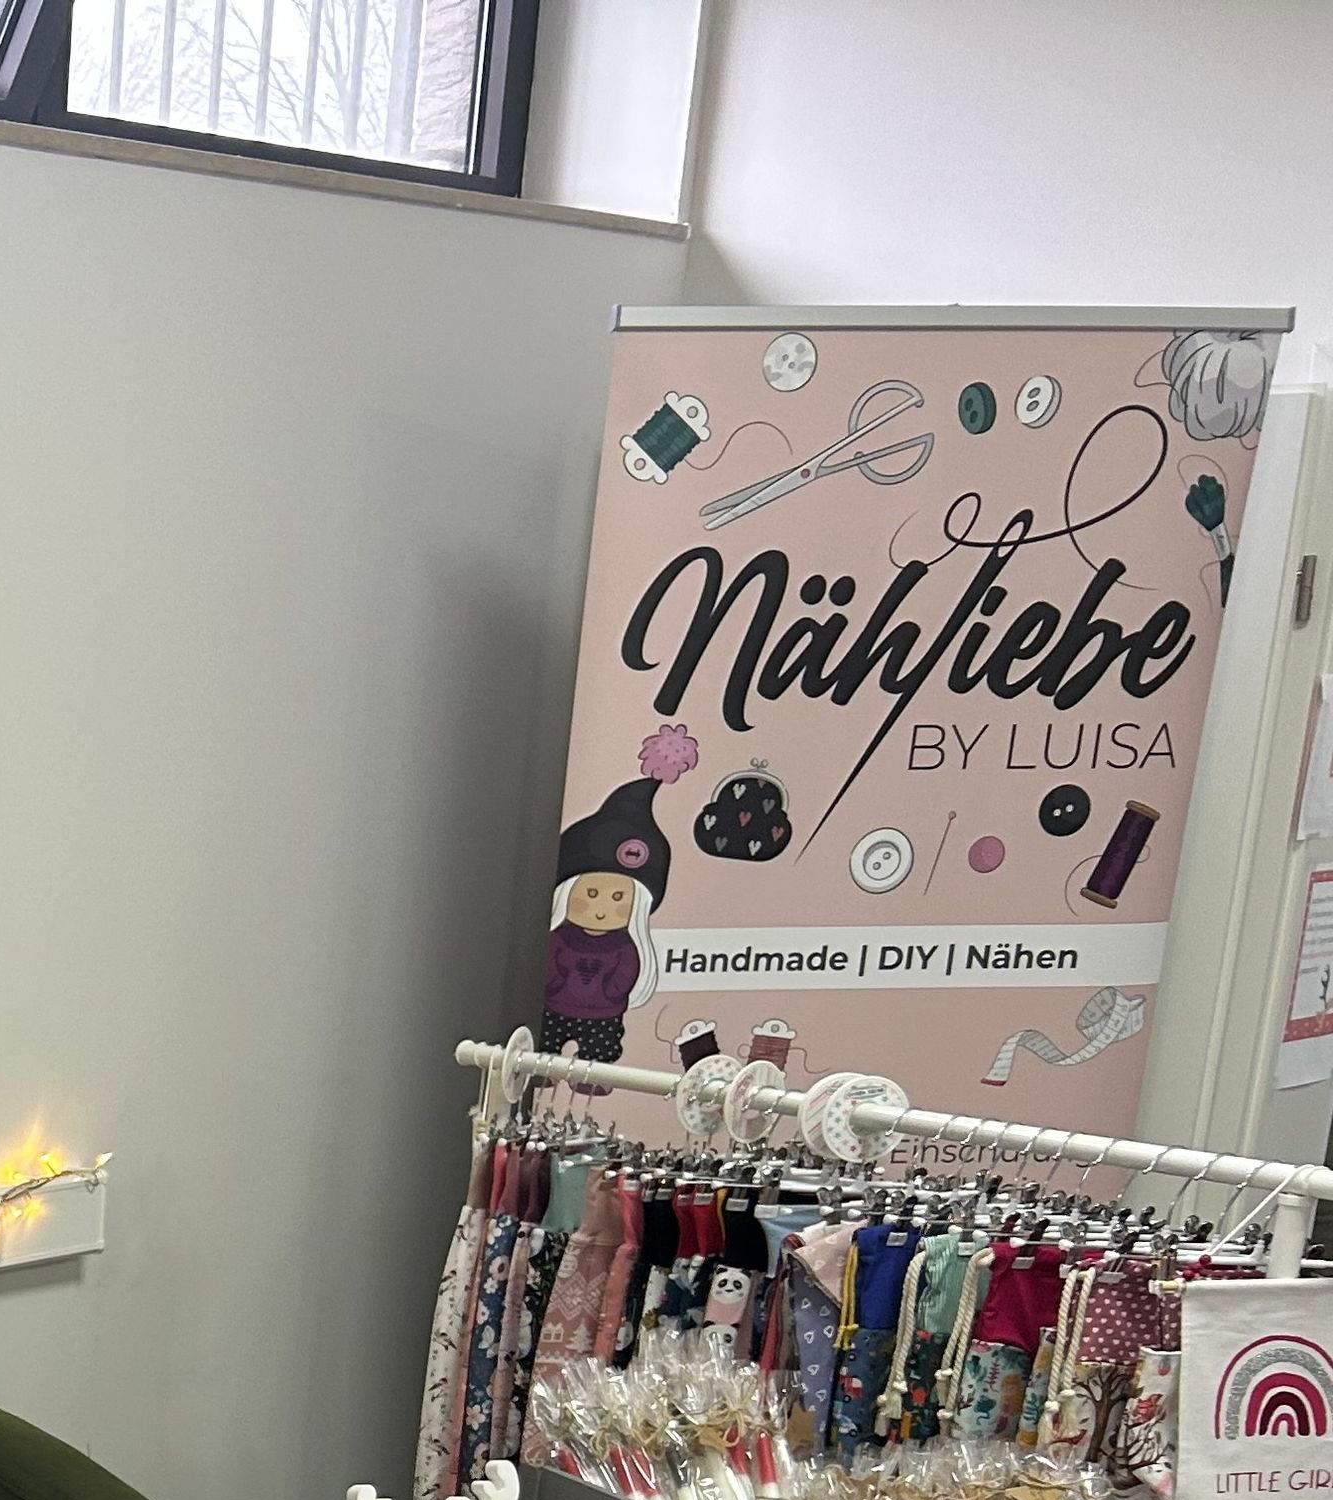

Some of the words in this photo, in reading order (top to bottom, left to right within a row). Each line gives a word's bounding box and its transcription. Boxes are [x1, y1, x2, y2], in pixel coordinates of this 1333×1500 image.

[621, 509, 1195, 735] Nähliebe
[908, 723, 981, 771] BY
[1006, 723, 1177, 771] LUISA
[664, 946, 850, 976] Handmade
[878, 944, 938, 974] DIY
[965, 943, 1079, 972] Nähen
[1217, 1471, 1281, 1493] LITTLE
[1289, 1469, 1333, 1490] GIR
